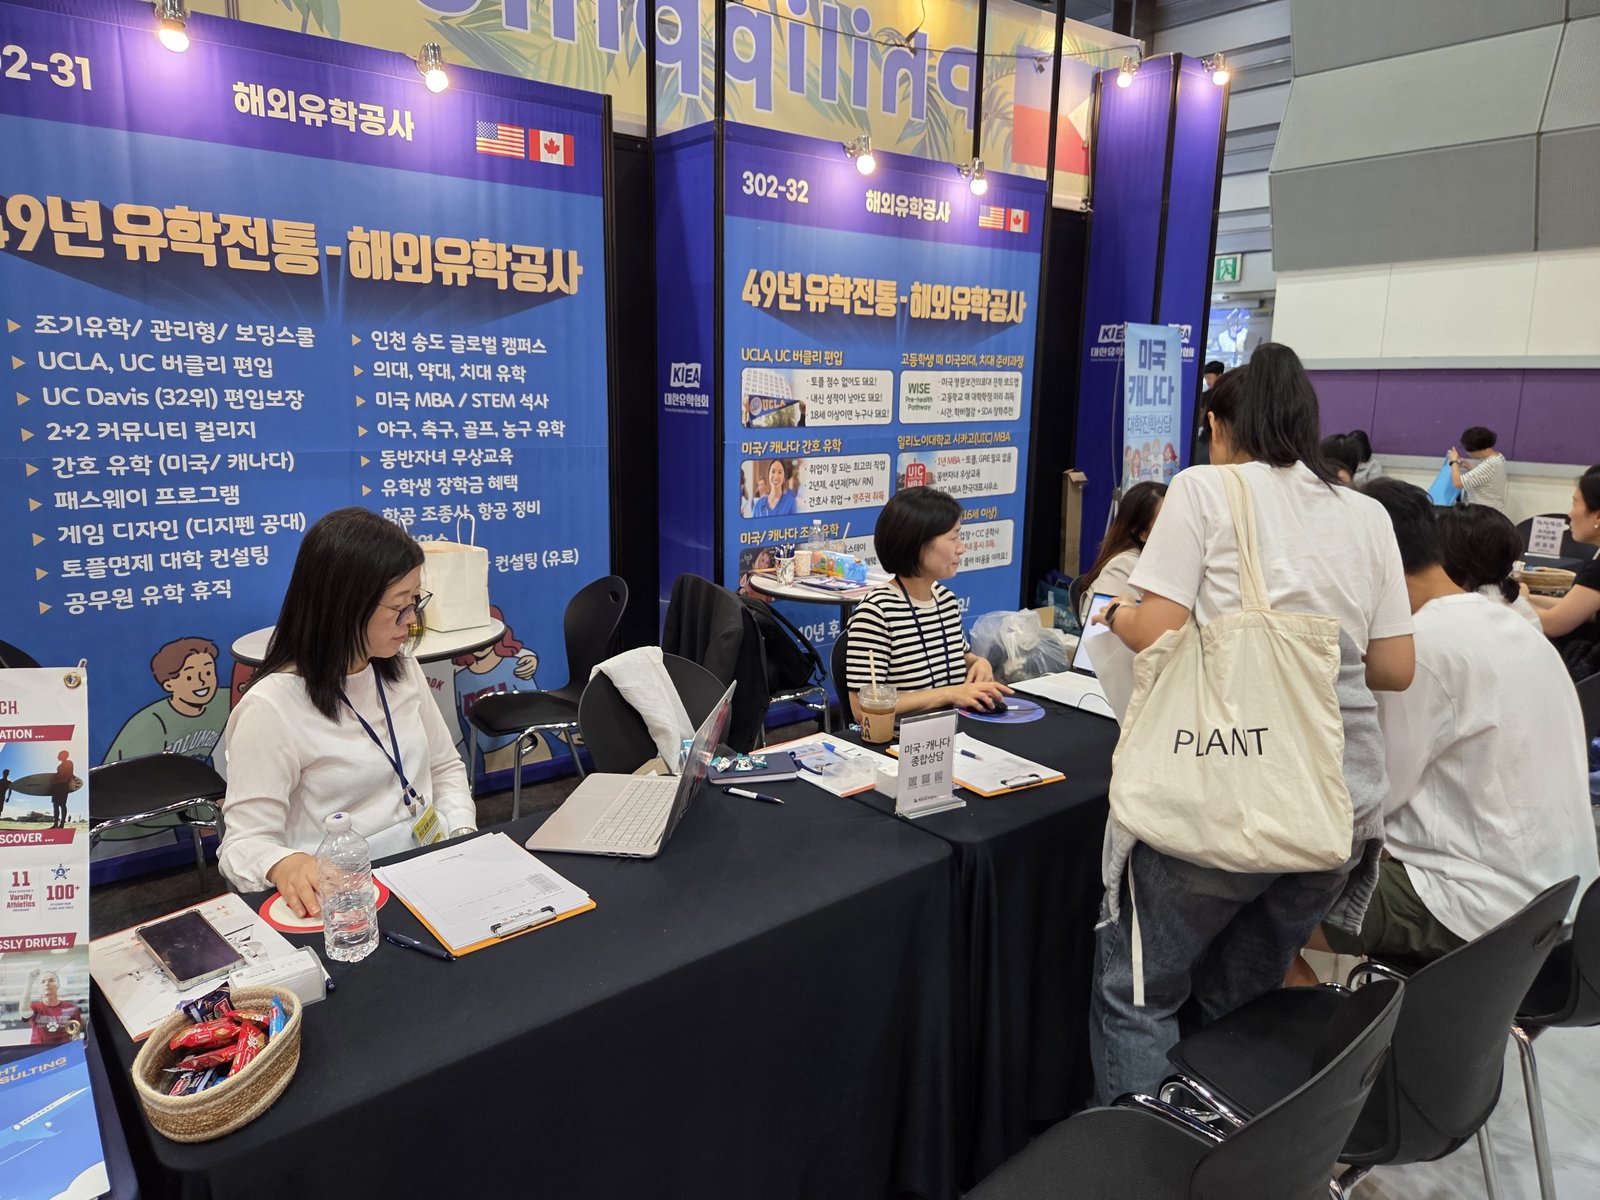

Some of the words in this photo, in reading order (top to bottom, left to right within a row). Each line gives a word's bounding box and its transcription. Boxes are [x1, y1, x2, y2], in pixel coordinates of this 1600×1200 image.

[0, 44, 92, 91] 2-31
[232, 81, 415, 141] 해외유학공사
[741, 171, 809, 203] 302-32
[865, 190, 951, 223] 해외유학공사
[112, 203, 320, 275] 유학전통
[347, 226, 583, 295] 해외유학공사
[741, 269, 801, 311] 49년
[804, 273, 898, 317] 유학전통
[910, 281, 1026, 323] 해외유학공사
[34, 315, 143, 340] 조기유학/
[150, 319, 228, 344] 관리형/
[235, 324, 316, 348] 보딩스쿨
[1101, 327, 1125, 341] KIE
[371, 331, 406, 351] 인천
[411, 332, 446, 352] 송도
[449, 334, 497, 355] 글로벌
[501, 337, 547, 356] 캠퍼스
[37, 351, 113, 374] UCLA,
[120, 353, 155, 372] UC
[161, 354, 226, 377] 버클리
[232, 356, 273, 378] 편입
[741, 348, 773, 364] UCLA,
[775, 350, 791, 362] UC
[792, 350, 822, 365] 버클리
[824, 351, 843, 366] 편입
[901, 353, 934, 368] 고등학생
[1138, 339, 1167, 371] 미국
[373, 361, 414, 381] 의대,
[418, 363, 456, 382] 약대,
[460, 363, 492, 381] 치대
[496, 364, 527, 383] 유학
[672, 365, 700, 385] KIEA
[811, 377, 824, 388] 토플
[826, 377, 839, 388] 점수
[908, 383, 930, 394] WISE
[941, 378, 953, 387] 미국
[1129, 376, 1174, 406] 캐나다
[42, 387, 80, 406] UC
[86, 387, 149, 407] Davis
[154, 387, 218, 410] (32위)
[223, 389, 305, 410] 편입보장
[376, 391, 410, 410] 미국
[415, 393, 454, 408] MBA
[472, 393, 516, 408] STEM
[520, 393, 549, 411] 석사
[664, 393, 709, 408] 대한유학협회
[763, 399, 785, 411] UCLA
[811, 393, 824, 404] 내신
[826, 393, 846, 405] 성적이
[854, 409, 873, 418] 누구나
[45, 422, 91, 441] 2+2
[97, 422, 187, 442] 커뮤니티
[195, 421, 256, 442] 컬리지
[377, 421, 417, 439] 야구,
[421, 420, 459, 439] 축구,
[463, 421, 499, 439] 골프,
[502, 421, 532, 439] 농구
[536, 420, 566, 438] 유학
[1127, 415, 1172, 435] 대학진학상담
[770, 440, 800, 454] 캐나다
[802, 440, 821, 454] 간호
[823, 439, 842, 452] 유학
[994, 432, 1010, 442] MBA
[52, 456, 100, 479] 간호
[106, 454, 153, 477] 유학
[227, 451, 295, 473] 캐나다)
[380, 449, 447, 470] 동반자녀
[452, 447, 513, 466] 무상교육
[810, 464, 829, 474] 취업이
[839, 463, 851, 472] 되는
[853, 461, 871, 470] 최고의
[874, 460, 885, 470] 직업
[908, 466, 923, 475] UIC
[381, 477, 431, 497] 유학생
[436, 476, 484, 495] 장학금
[488, 474, 518, 492] 혜택
[54, 488, 147, 510] 패스웨이
[154, 485, 240, 506] 프로그램
[809, 496, 828, 507] 간호사
[830, 495, 842, 505] 취업
[478, 502, 507, 521] 항공
[512, 500, 541, 519] 정비
[58, 524, 105, 546] 게임
[112, 519, 179, 541] 디자인
[186, 516, 255, 539] (디지펜
[260, 511, 307, 535] 공대)
[768, 528, 798, 541] 캐나다
[61, 554, 153, 580] 토플면제
[160, 551, 203, 571] 대학
[210, 545, 270, 568] 컨설팅
[495, 552, 538, 572] 컨설팅
[542, 548, 580, 568] (유료)
[64, 588, 134, 615] 공무원
[141, 584, 185, 606] 유학
[190, 579, 232, 601] 휴직
[1173, 728, 1269, 757] PLANT
[911, 751, 944, 767] 종합상담
[12, 871, 30, 887] 11
[7, 901, 35, 909] Athletics
[10, 893, 32, 902] Varsity
[25, 936, 69, 948] DRIVEN.
